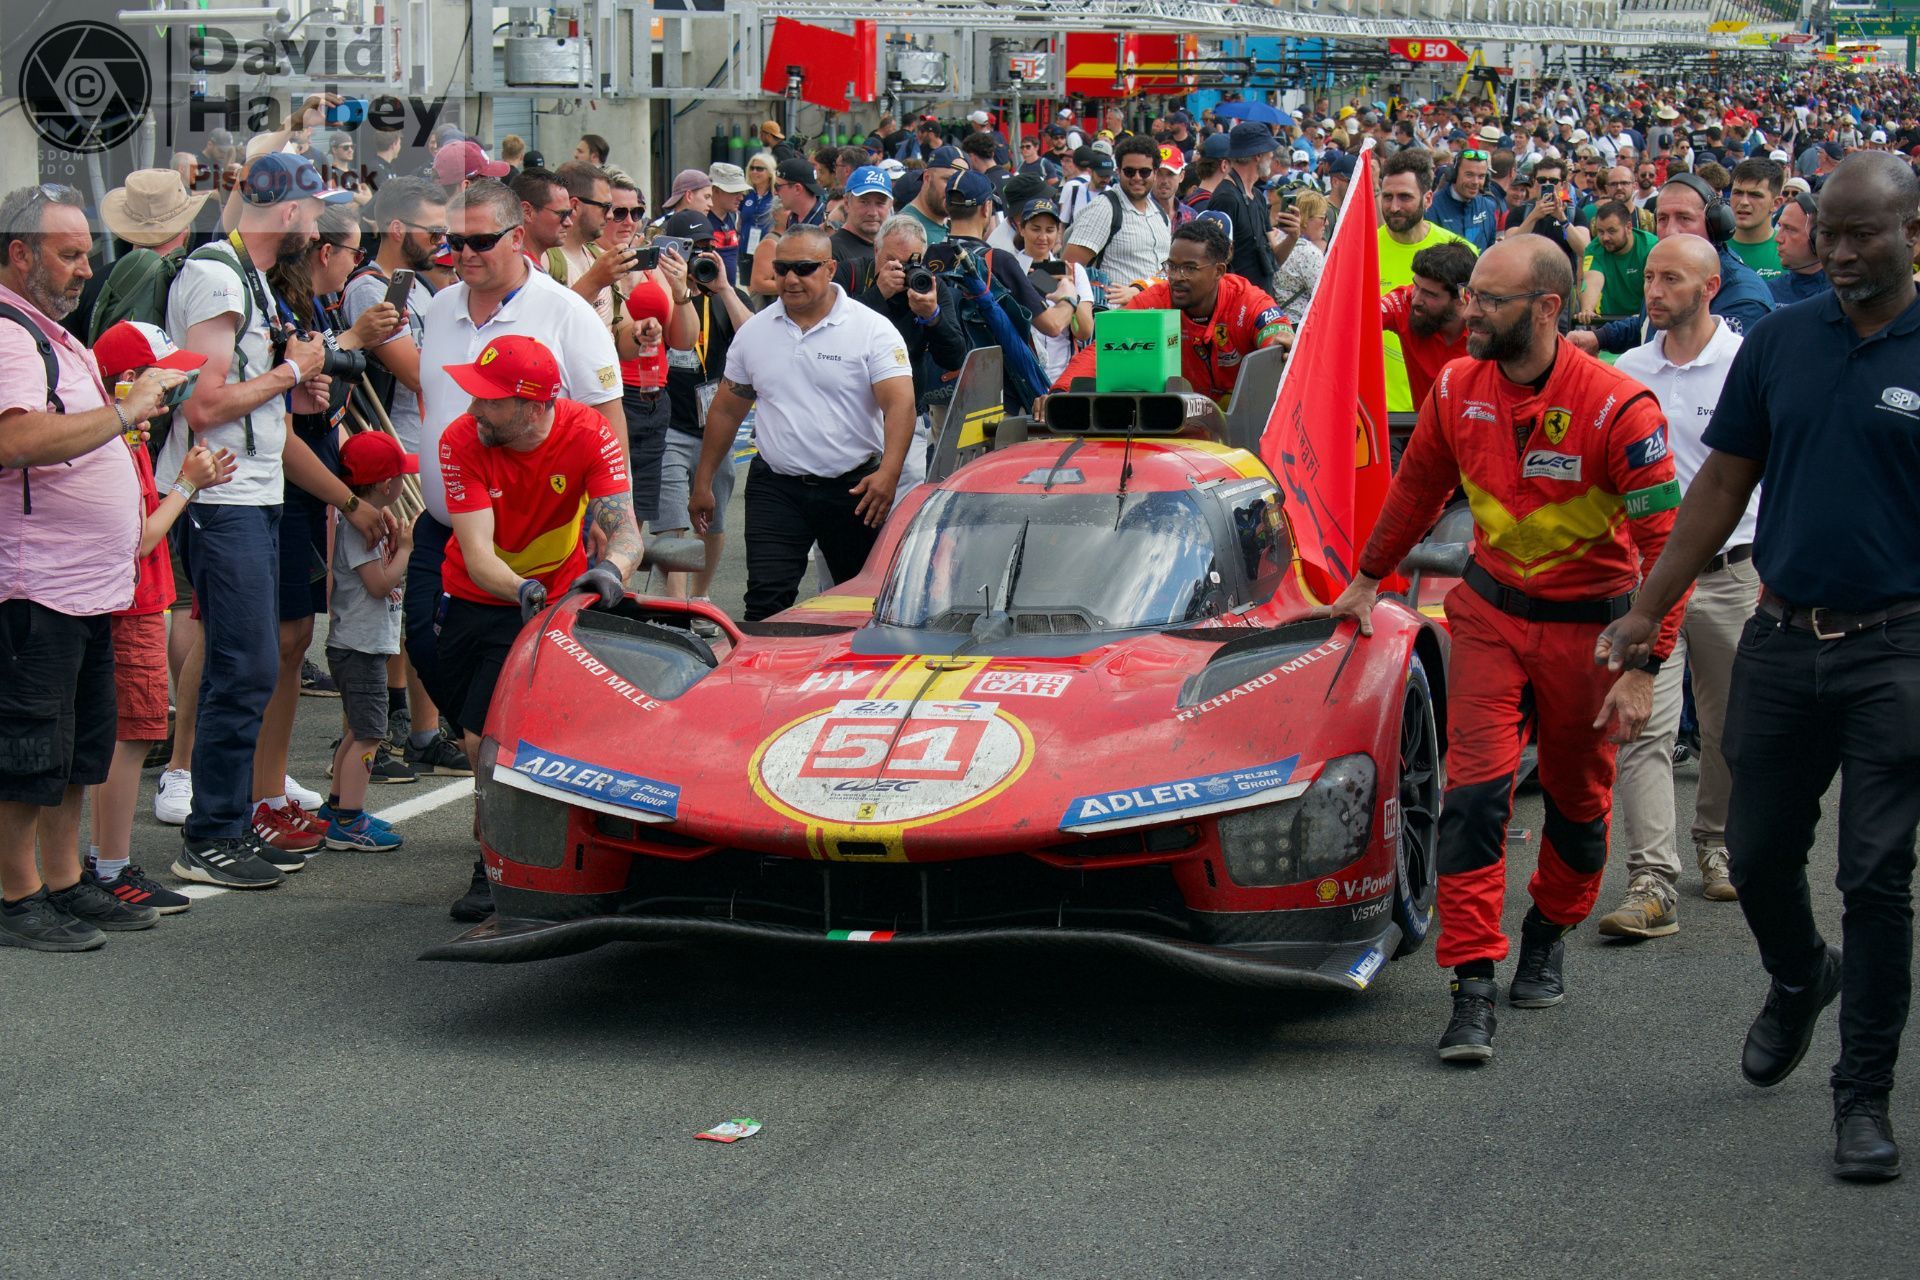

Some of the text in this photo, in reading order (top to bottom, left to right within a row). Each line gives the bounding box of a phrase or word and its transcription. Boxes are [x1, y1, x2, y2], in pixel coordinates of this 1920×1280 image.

[1424, 43, 1449, 58] 50
[1103, 342, 1156, 351] SAFE
[817, 352, 842, 362] Events
[1594, 394, 1617, 431] Sabelt
[1644, 429, 1666, 458] 24h
[1527, 454, 1578, 470] WEC
[1280, 640, 1346, 675] MILLE
[545, 629, 660, 711] RICHARD MILLE
[988, 672, 1066, 684] HYPER
[797, 671, 876, 692] HY
[980, 679, 1059, 695] CAR
[812, 725, 961, 771] 51
[515, 757, 614, 792] ADLER
[1233, 769, 1278, 782] PELZER
[640, 784, 677, 799] PELZER
[834, 780, 921, 792] WEC
[1237, 778, 1282, 791] GROUP
[631, 792, 667, 807] GROUP
[1079, 782, 1200, 819] ADLER
[1344, 870, 1395, 900] V-Power
